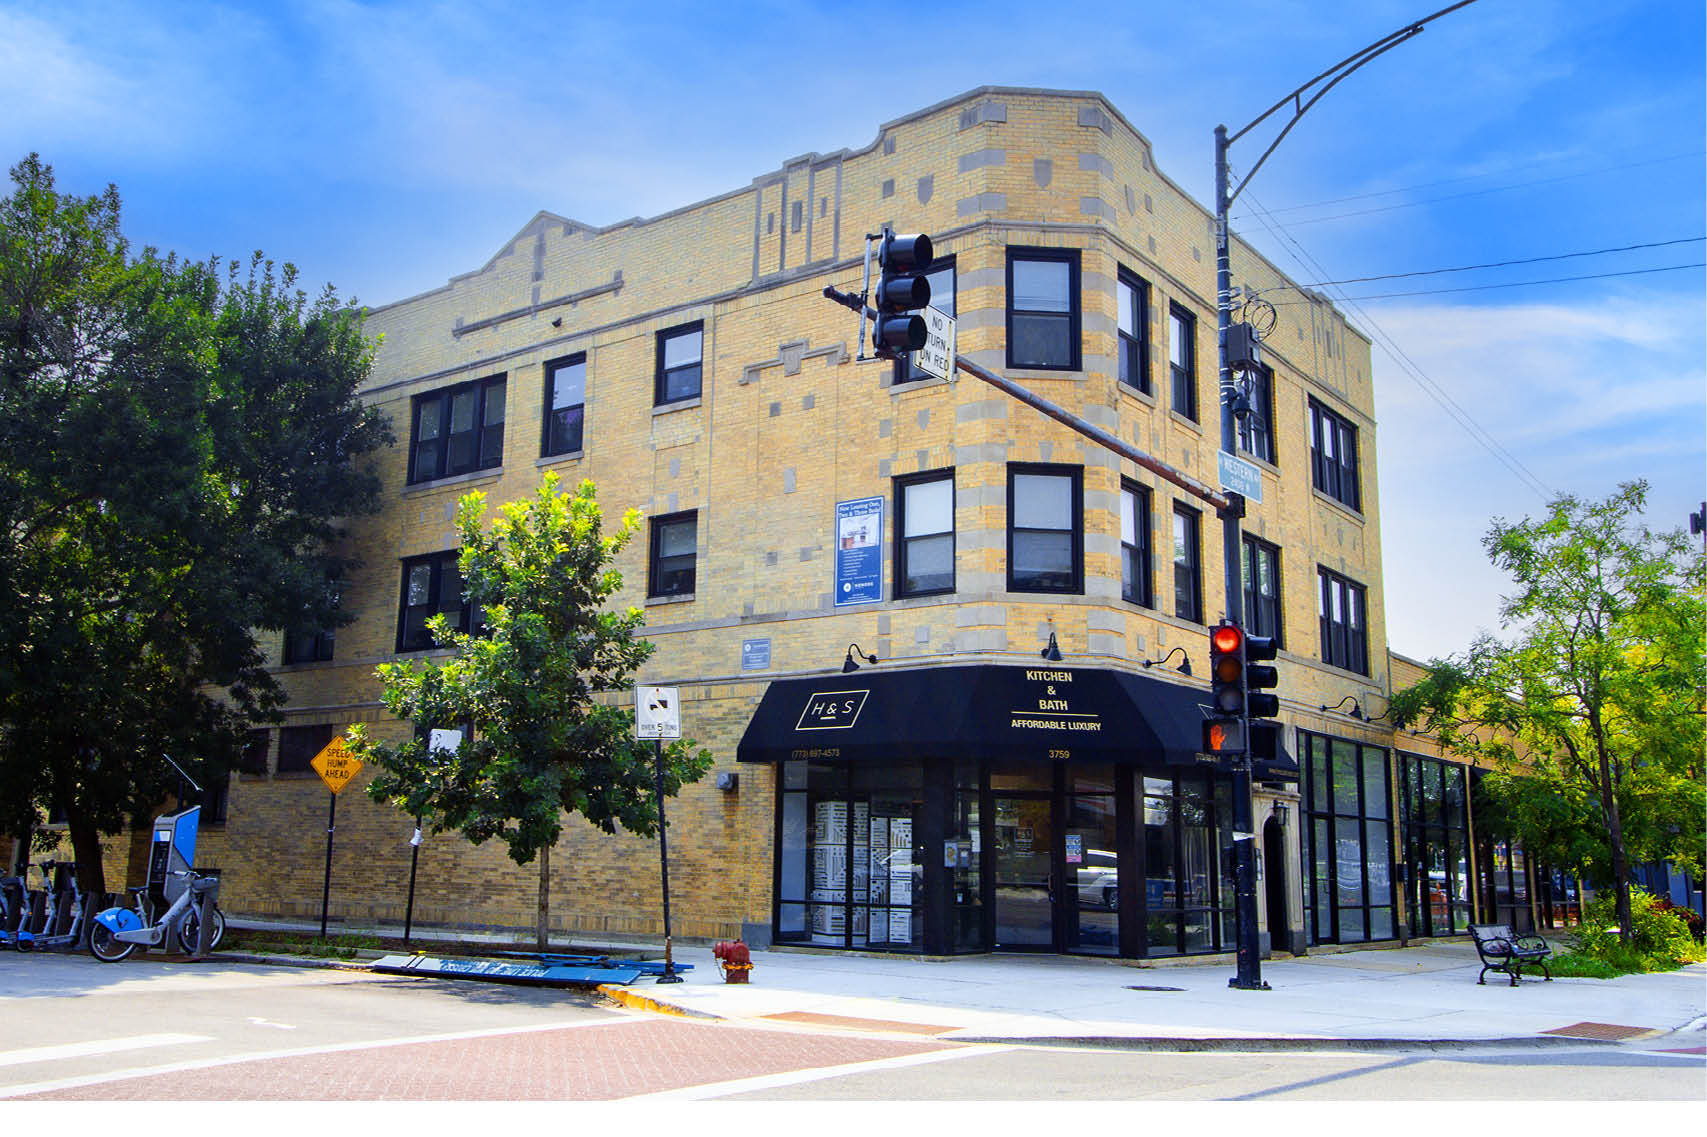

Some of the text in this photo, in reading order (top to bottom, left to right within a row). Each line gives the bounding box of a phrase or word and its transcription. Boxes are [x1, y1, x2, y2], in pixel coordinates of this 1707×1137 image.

[932, 314, 943, 331] NO
[927, 332, 946, 351] TURN
[920, 348, 949, 371] ON RED
[1026, 670, 1073, 682] KITCHEN
[1047, 685, 1056, 695] &
[811, 700, 855, 715] H & S
[1039, 699, 1068, 711] BATH
[657, 723, 663, 731] 5
[1011, 719, 1102, 731] AFFORDABLE LUXURY
[1048, 749, 1070, 758] 3759
[327, 759, 348, 768] HUMP
[325, 769, 350, 779] AHEAD
